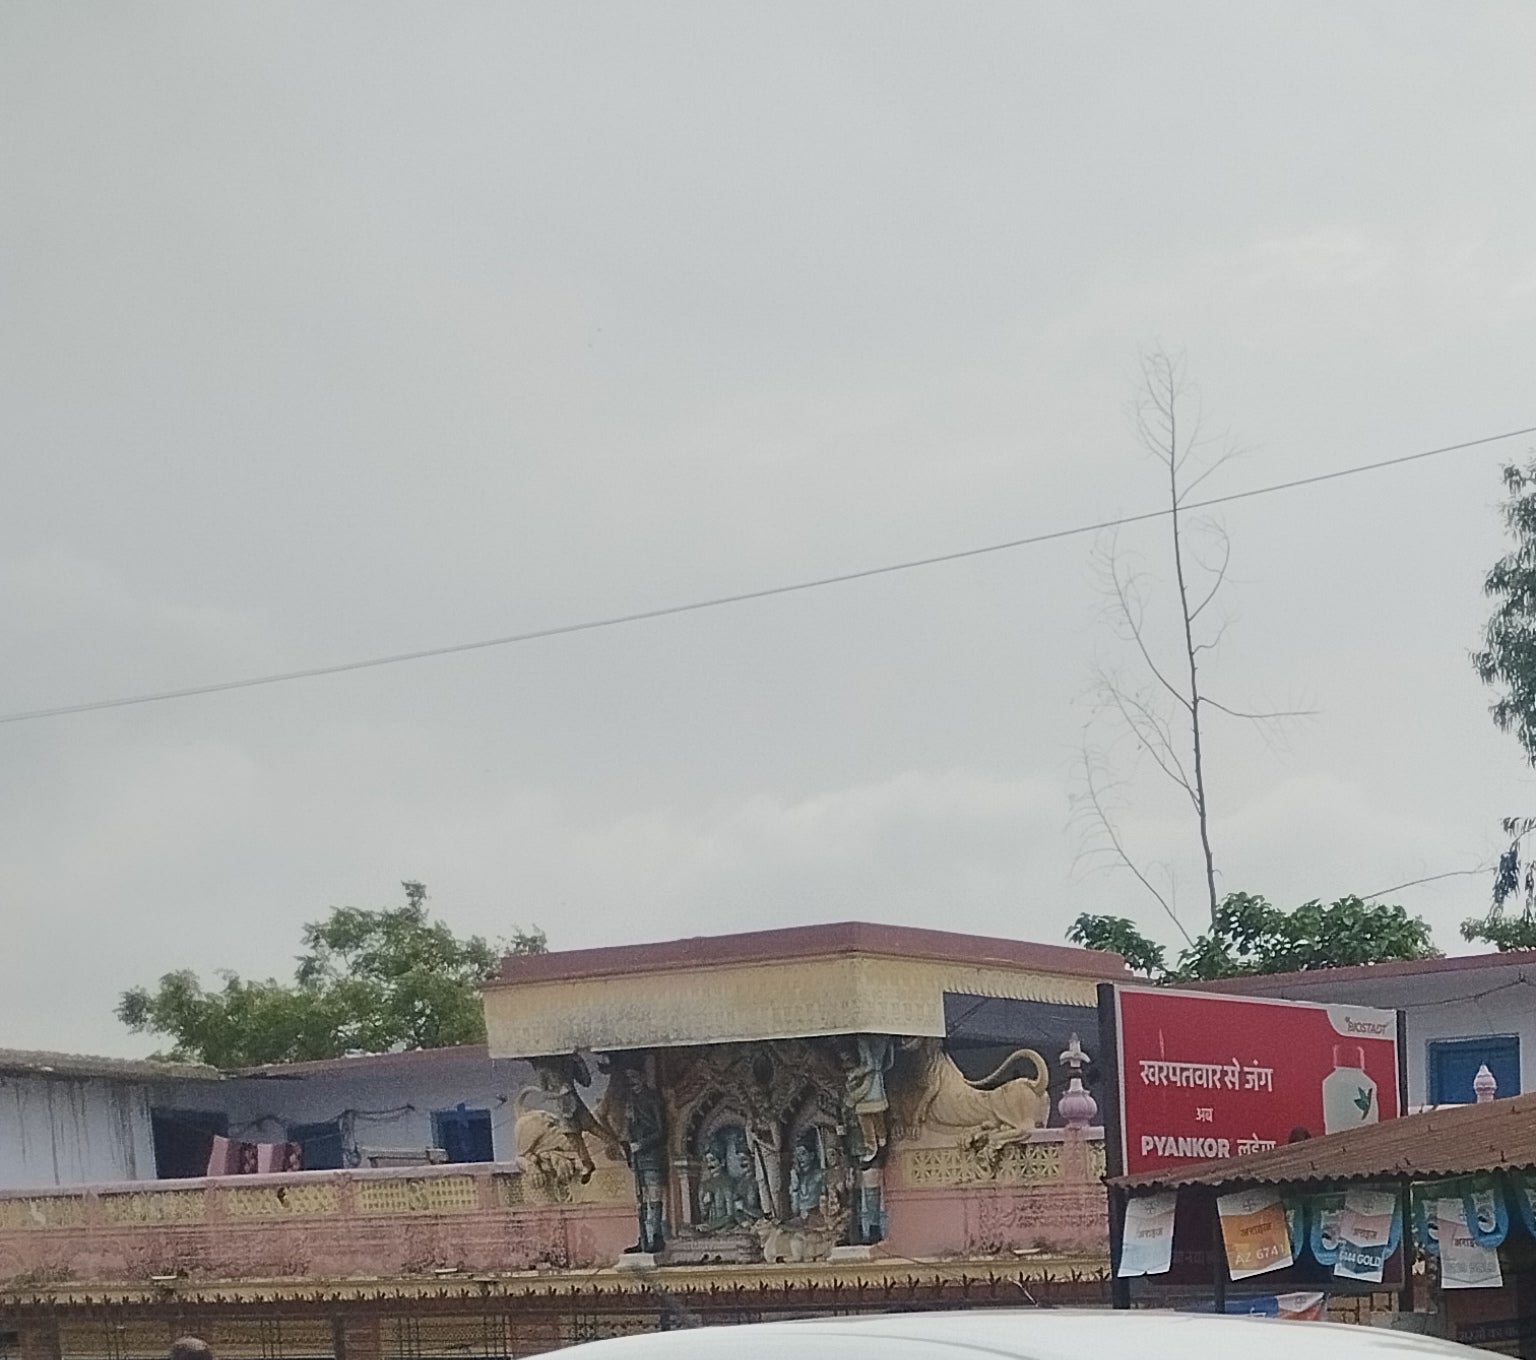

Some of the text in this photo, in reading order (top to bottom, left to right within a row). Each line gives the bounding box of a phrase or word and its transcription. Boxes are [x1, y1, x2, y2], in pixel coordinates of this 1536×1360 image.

[1139, 1057, 1274, 1092] खरपतवार से जंग
[1195, 1107, 1214, 1122] अब
[1140, 1135, 1231, 1159] PYANKOR
[1357, 1253, 1381, 1268] GOLD
